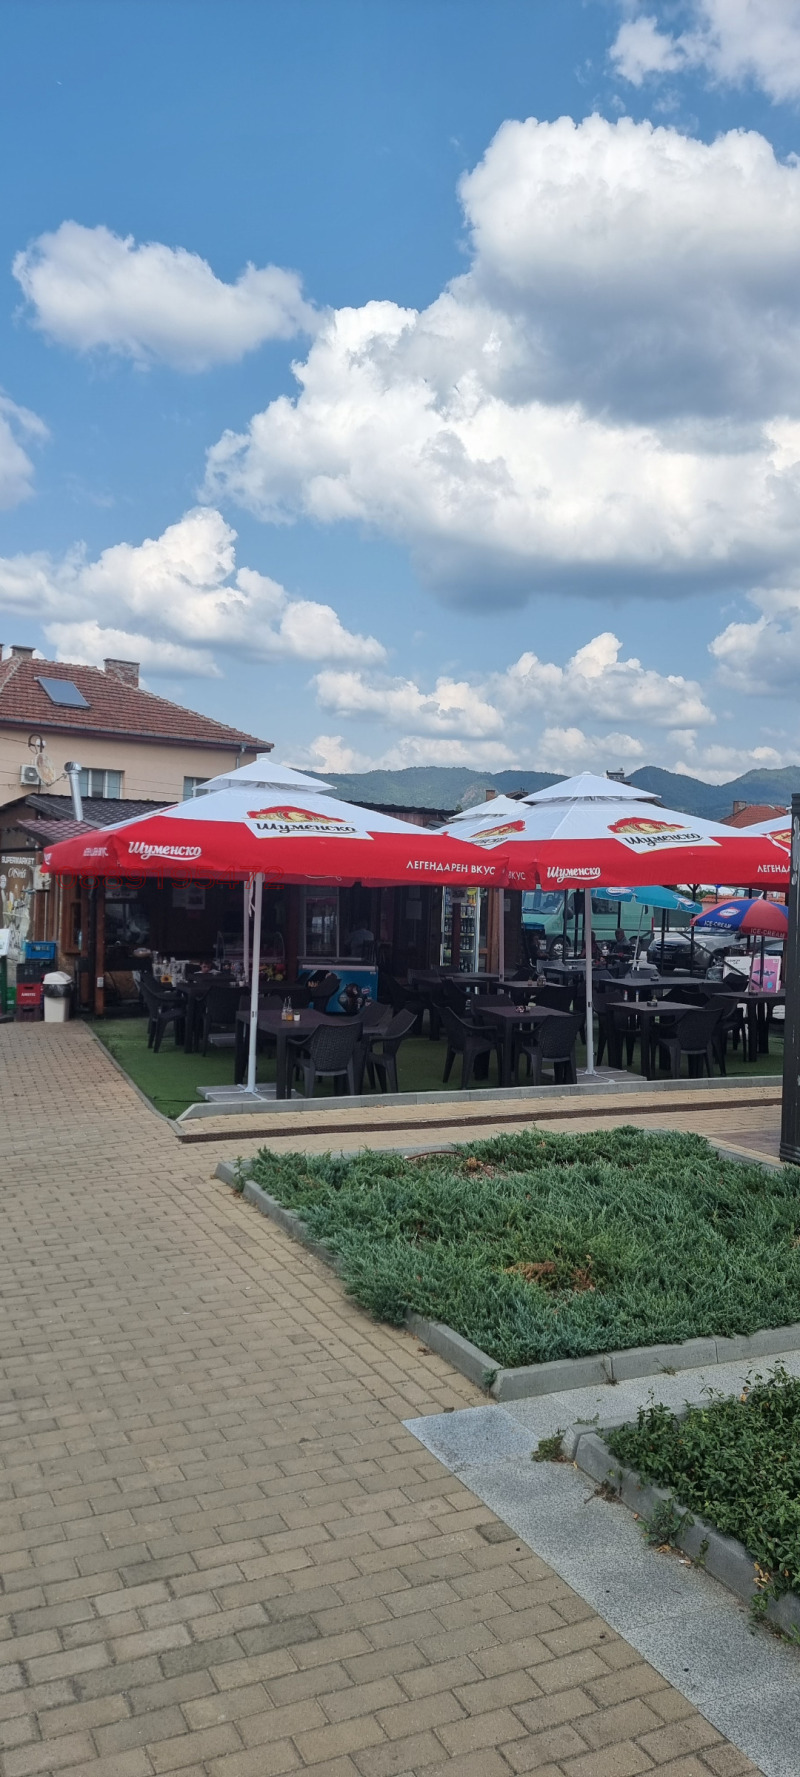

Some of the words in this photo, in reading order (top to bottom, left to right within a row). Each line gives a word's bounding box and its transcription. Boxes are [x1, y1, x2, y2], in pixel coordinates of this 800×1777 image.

[255, 823, 357, 834] Шуменско
[622, 833, 704, 846] Шуменско
[128, 841, 202, 861] Шуменско
[1, 855, 35, 865] SUPERMARKET
[406, 860, 468, 873] ЛЕГЕНДАРЕН
[470, 865, 496, 876] ВКУС
[547, 866, 602, 883] Шуменско
[703, 920, 732, 929] ICE-CREAM
[750, 928, 786, 939] ICE-CREAM
